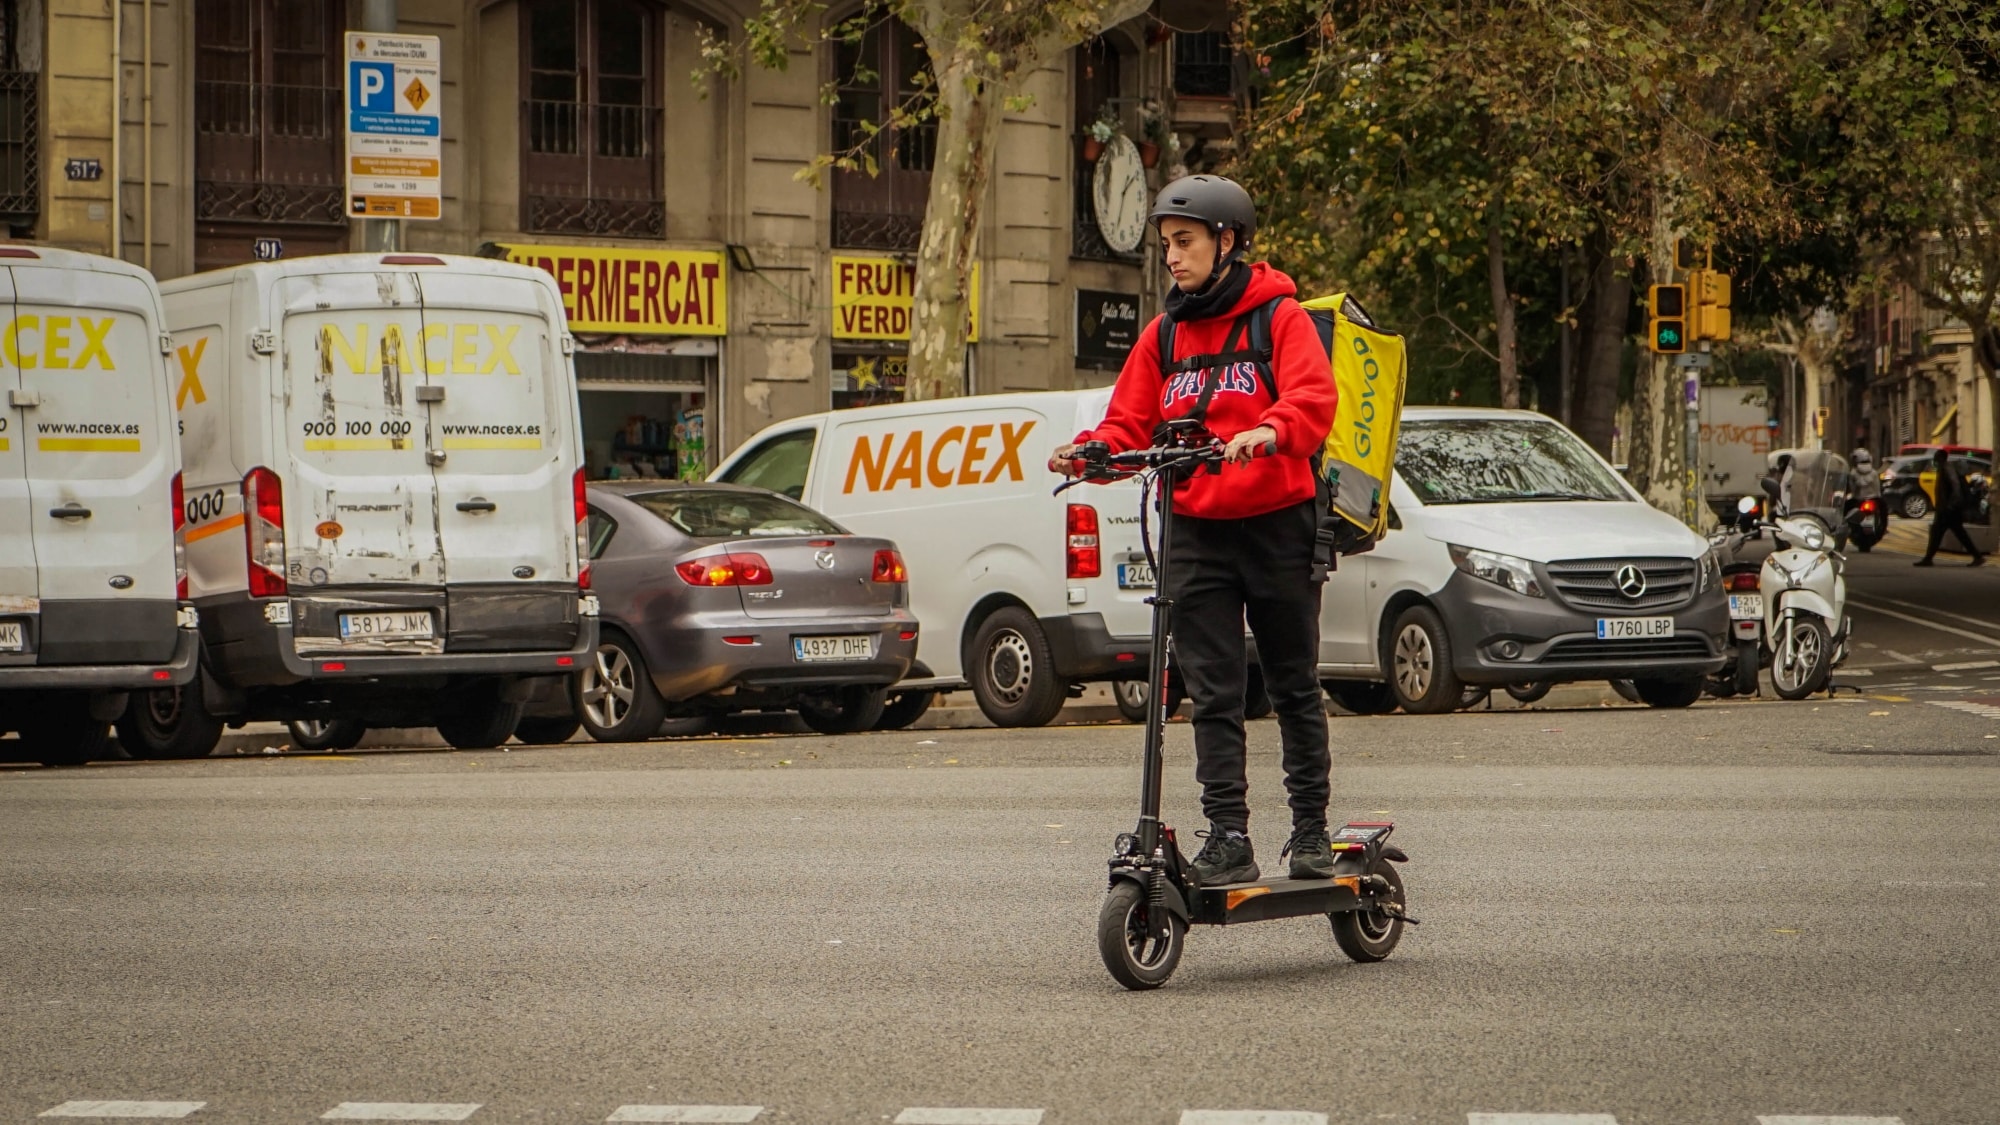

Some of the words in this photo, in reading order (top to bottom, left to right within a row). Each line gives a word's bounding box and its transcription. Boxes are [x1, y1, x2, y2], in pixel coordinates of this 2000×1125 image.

[360, 68, 385, 107] P
[71, 161, 98, 179] 317
[261, 246, 276, 259] 91
[513, 255, 719, 326] ERMERCAT
[840, 304, 912, 335] VERD
[0, 314, 116, 370] CEX
[319, 323, 521, 376] NACEX
[1353, 358, 1379, 459] Glovo
[38, 422, 139, 435] www.nacex.es
[303, 422, 336, 436] 900
[345, 422, 372, 436] 100
[380, 421, 411, 436] 000
[442, 423, 540, 435] www.nacex.es
[842, 420, 1037, 495] NACEX
[187, 489, 224, 525] 000
[337, 504, 402, 512] TRANSIT
[352, 616, 394, 633] 5812
[400, 615, 429, 632] JMK
[1609, 620, 1642, 636] 1760
[1647, 620, 1671, 635] LBP
[803, 639, 838, 655] 4937
[843, 638, 869, 655] DHF
